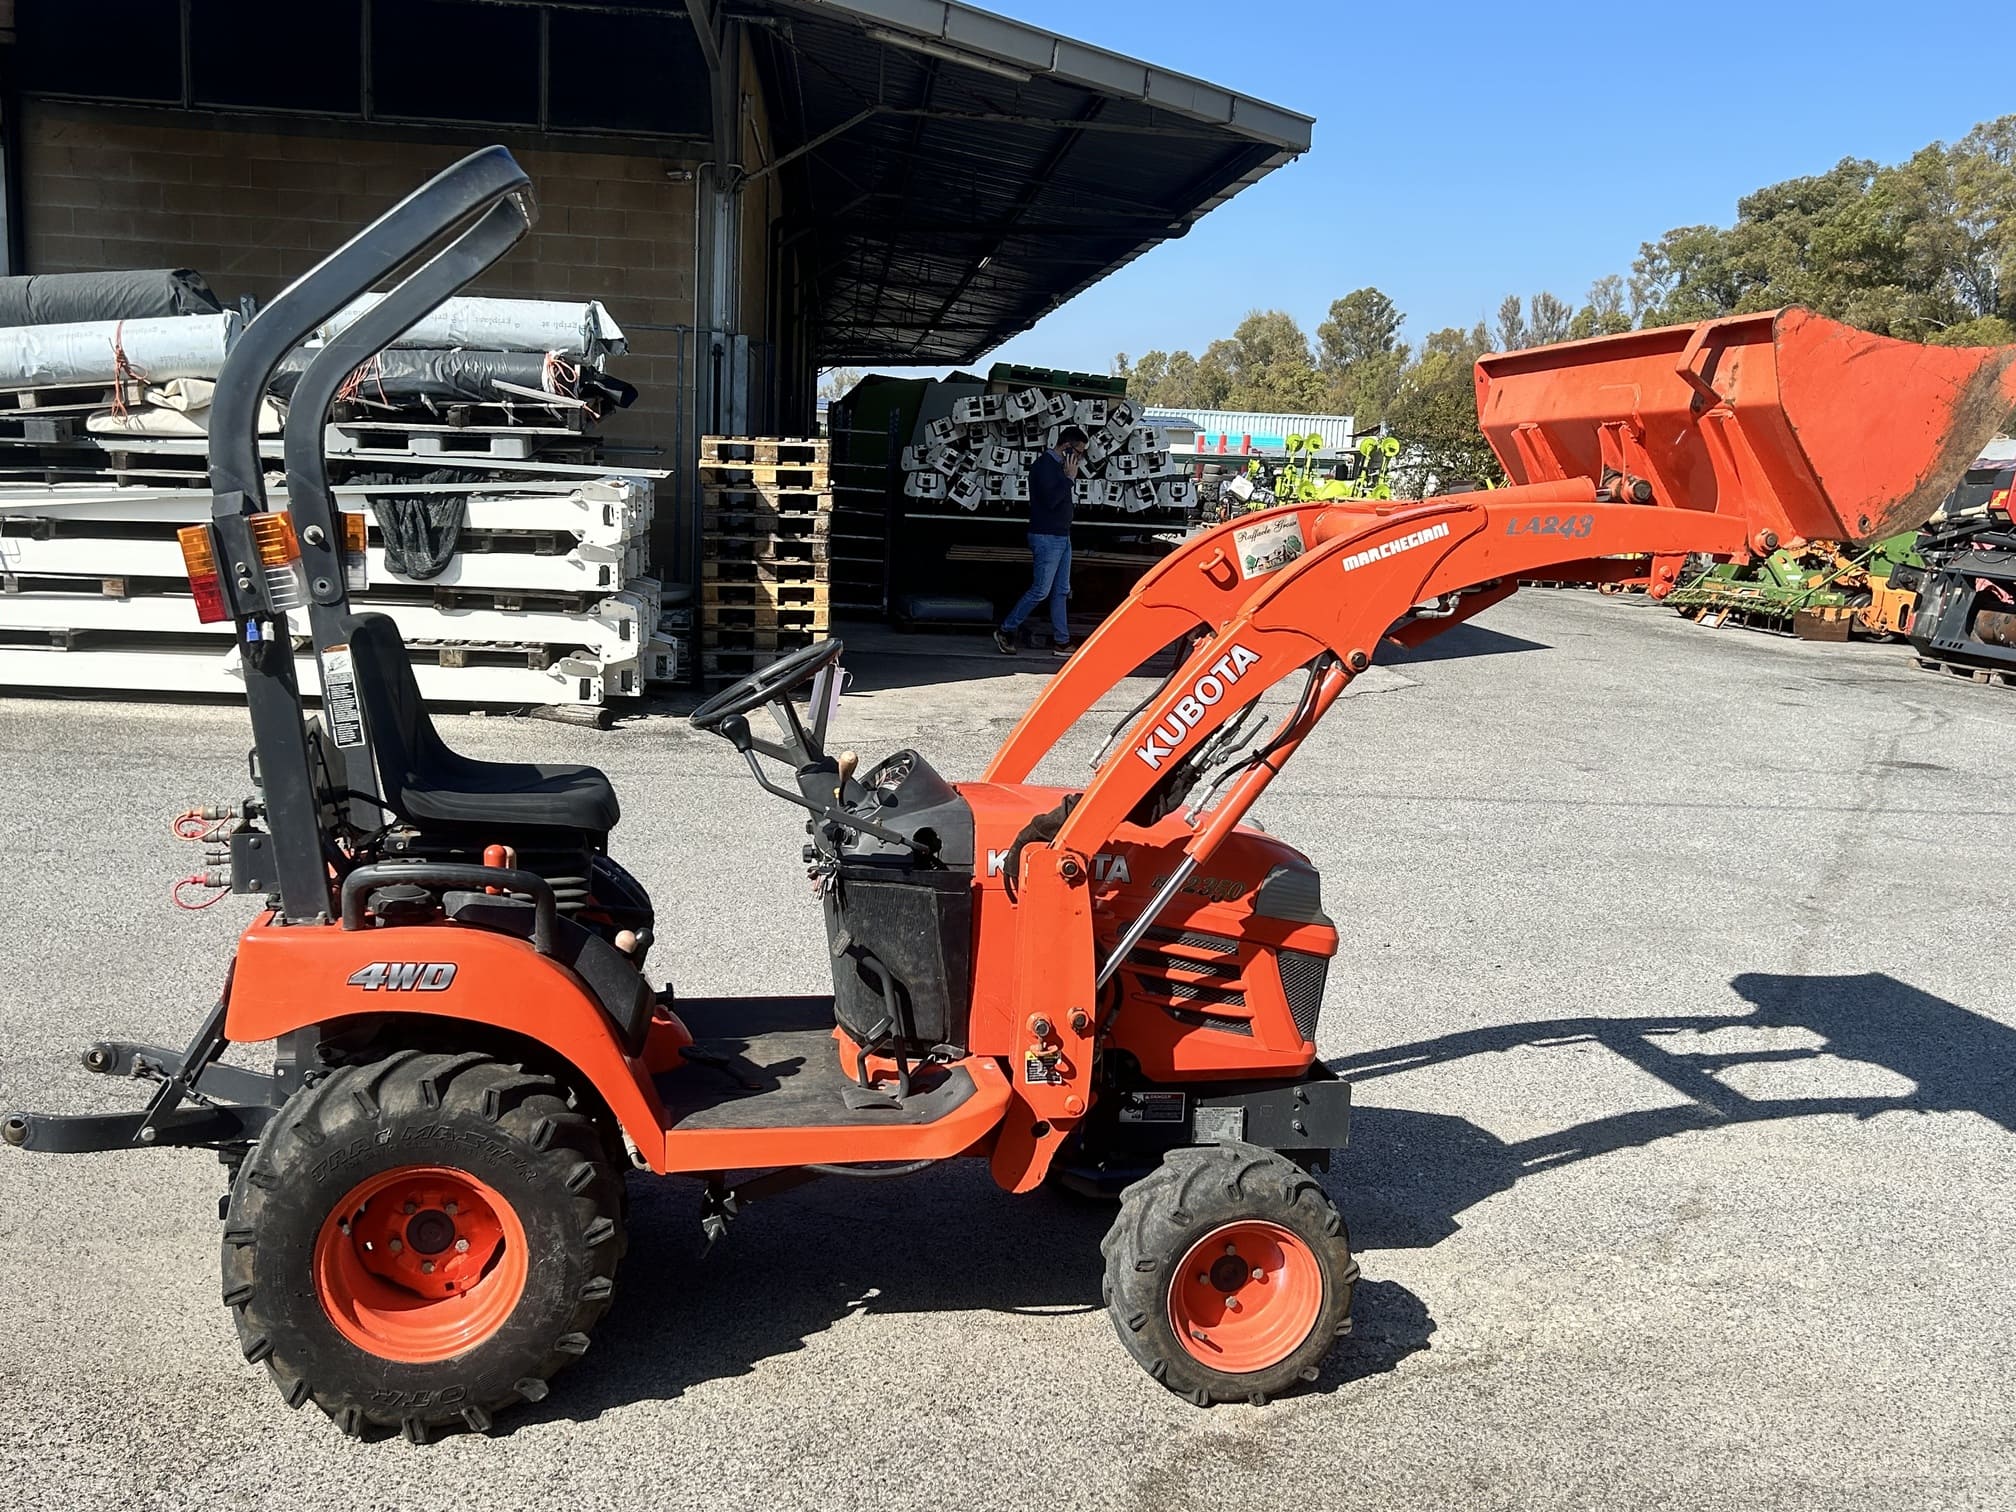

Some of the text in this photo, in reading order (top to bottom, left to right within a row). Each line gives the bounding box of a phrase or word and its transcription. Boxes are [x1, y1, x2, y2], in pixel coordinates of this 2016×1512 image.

[1505, 513, 1596, 539] LA243
[1342, 522, 1451, 572] MARCHEGIANI
[1134, 642, 1261, 771] KUBOTA
[987, 849, 1131, 883] KTA
[1152, 873, 1246, 902] B2350
[347, 961, 459, 992] 4WD
[401, 1122, 538, 1182] MASTER
